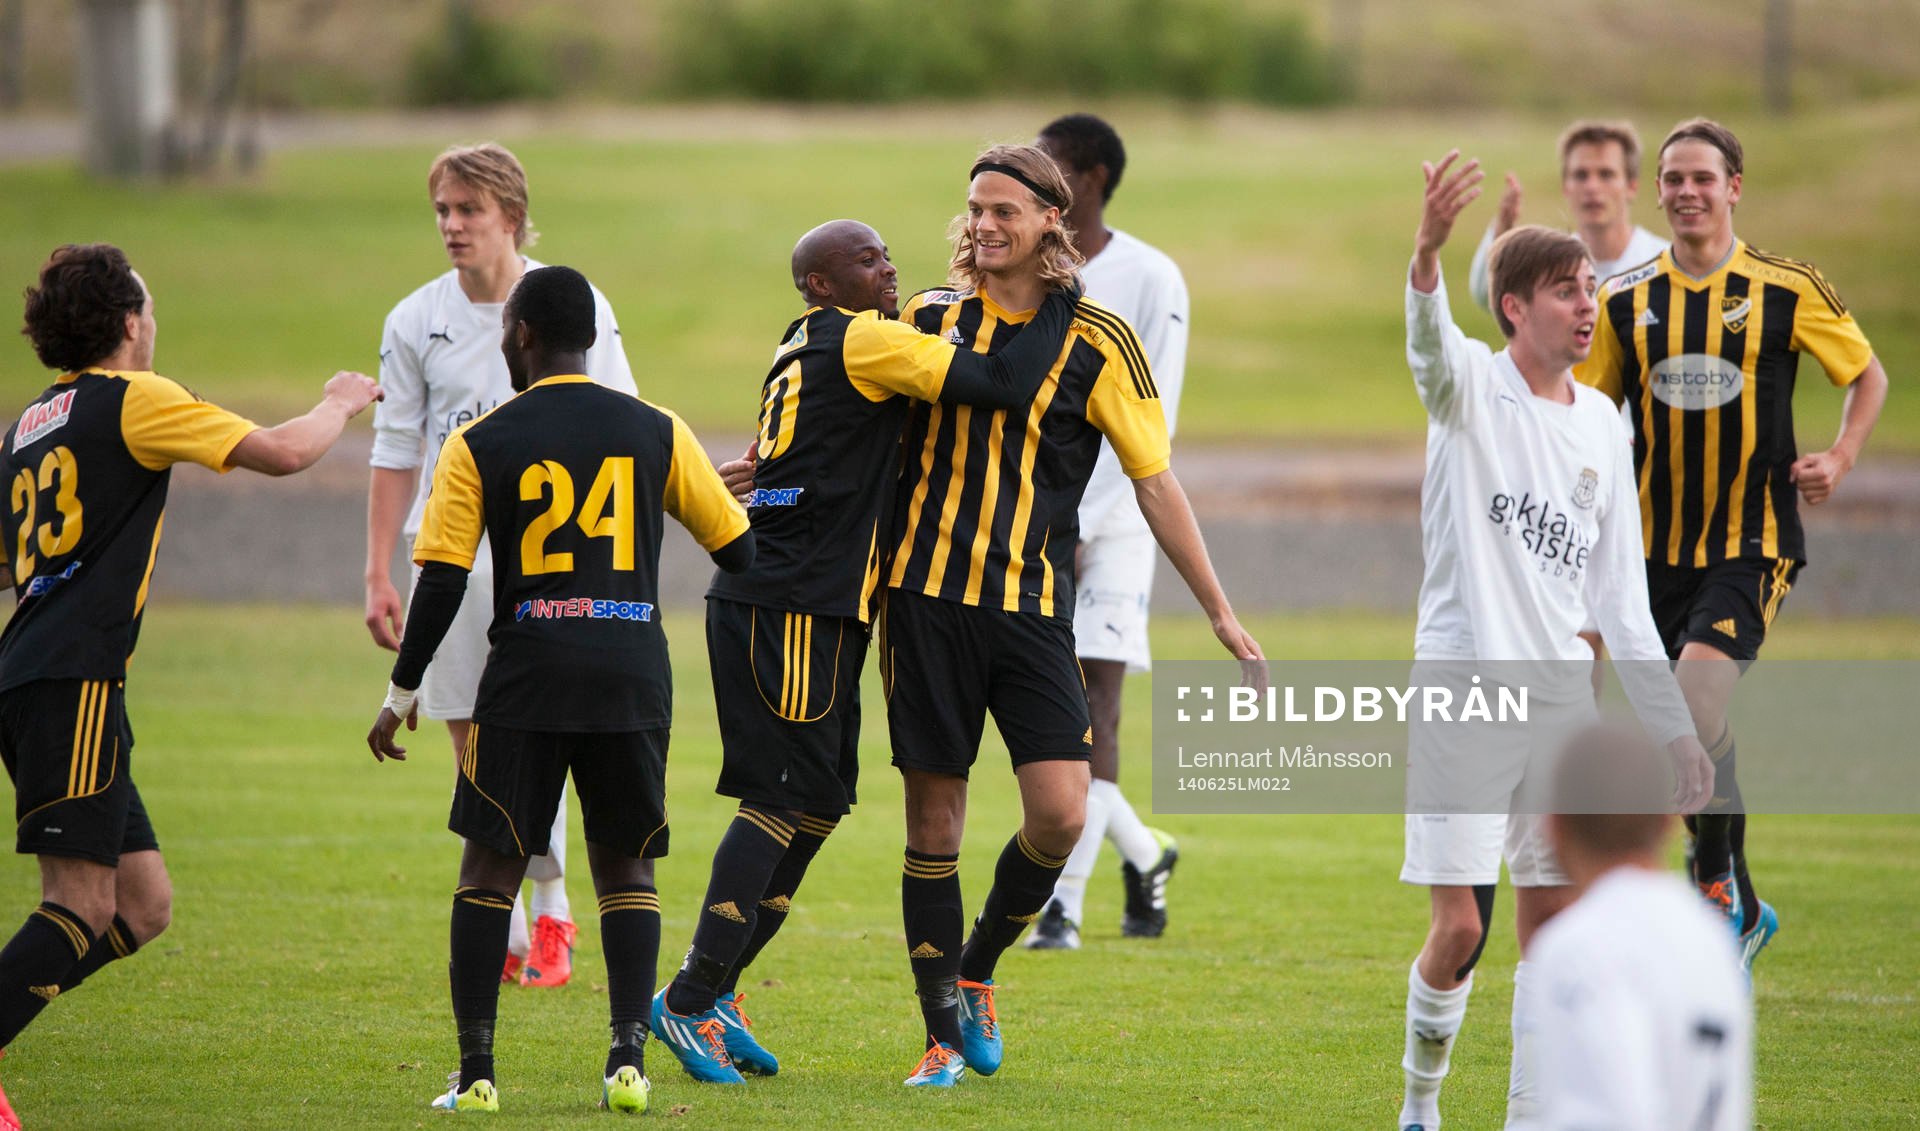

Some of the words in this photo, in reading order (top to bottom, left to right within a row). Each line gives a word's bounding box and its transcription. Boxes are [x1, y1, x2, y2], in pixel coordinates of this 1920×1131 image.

[18, 391, 74, 437] MAXI
[11, 445, 84, 587] 23
[519, 456, 635, 576] 24
[531, 597, 654, 622] INTERSPORT
